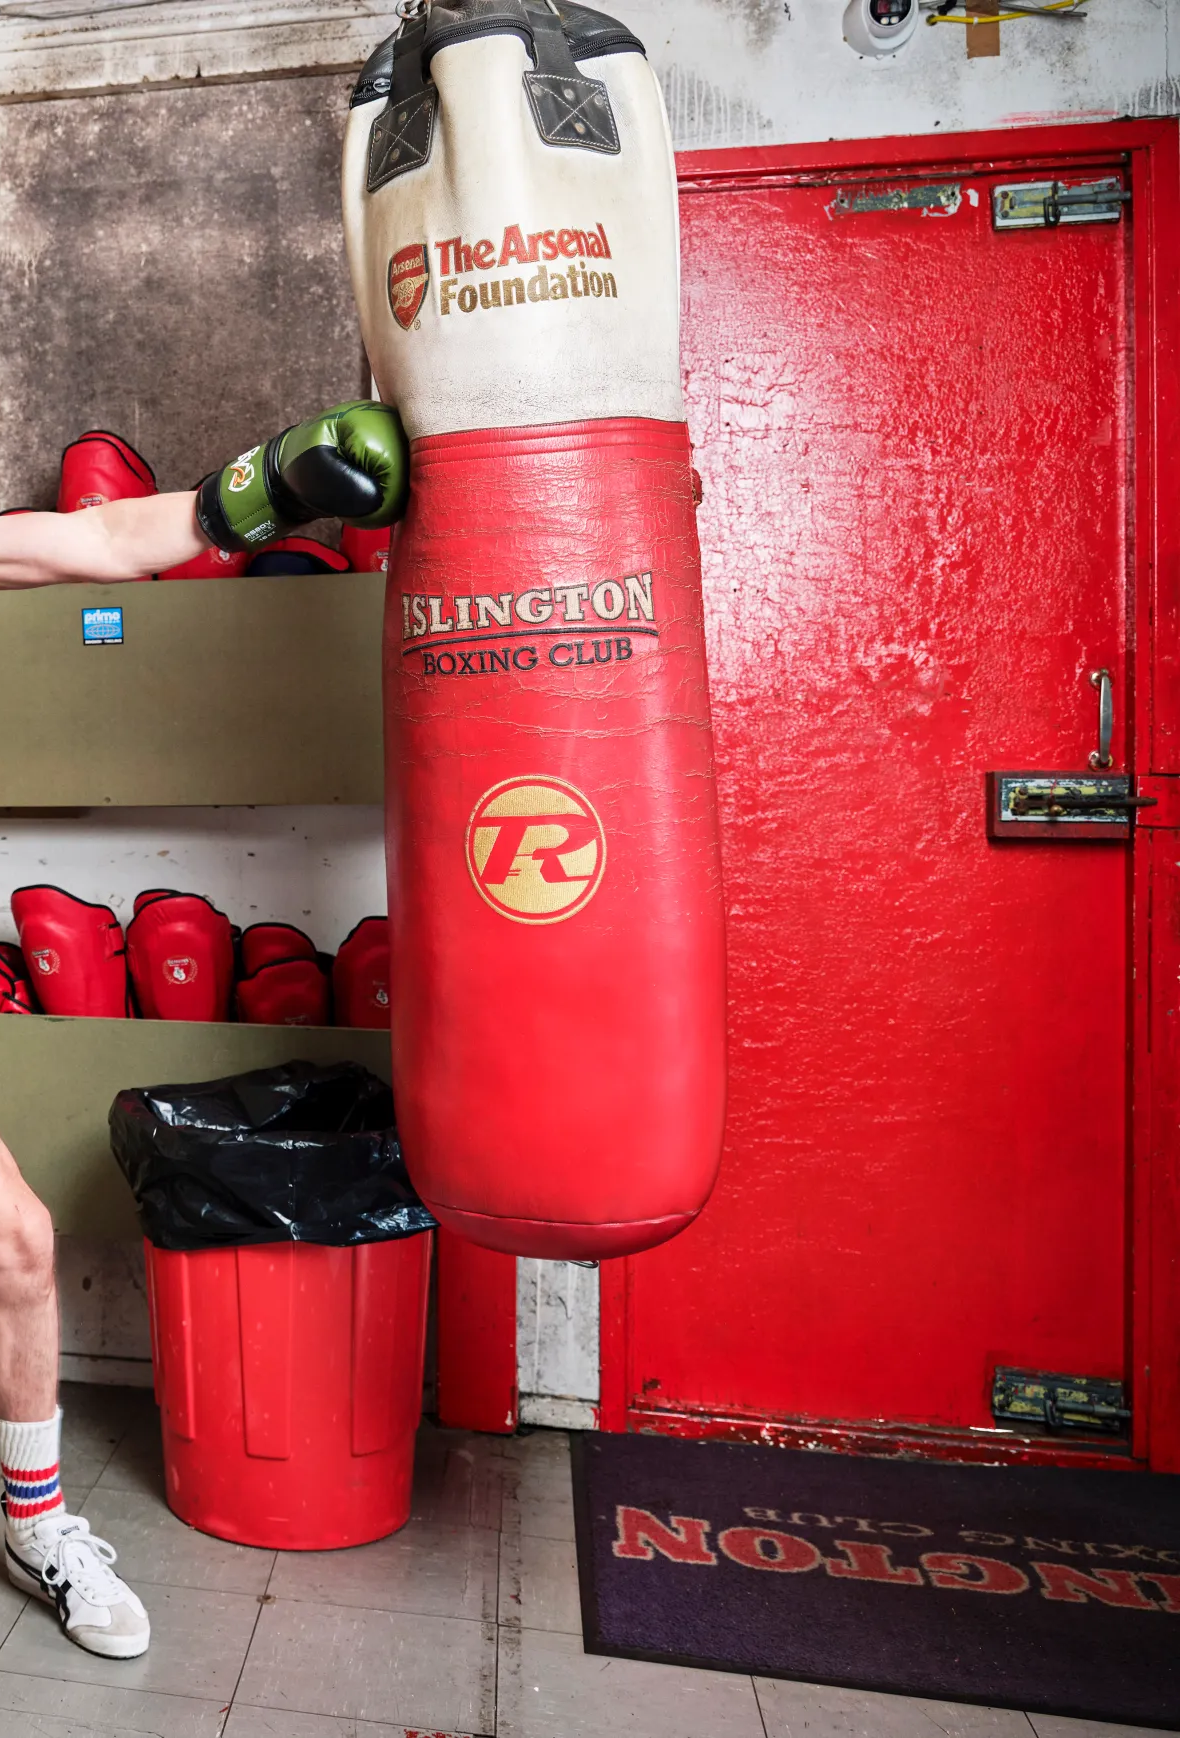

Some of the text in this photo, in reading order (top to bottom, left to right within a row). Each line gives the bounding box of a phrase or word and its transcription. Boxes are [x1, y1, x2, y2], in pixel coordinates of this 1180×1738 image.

[391, 256, 425, 277] Arsenal
[435, 222, 612, 277] The Arsenal
[440, 261, 618, 315] Foundation
[84, 609, 120, 624] primo
[402, 571, 656, 641] ISLINGTON
[423, 636, 633, 675] BOXING CLUB
[743, 1506, 934, 1537] CLUB
